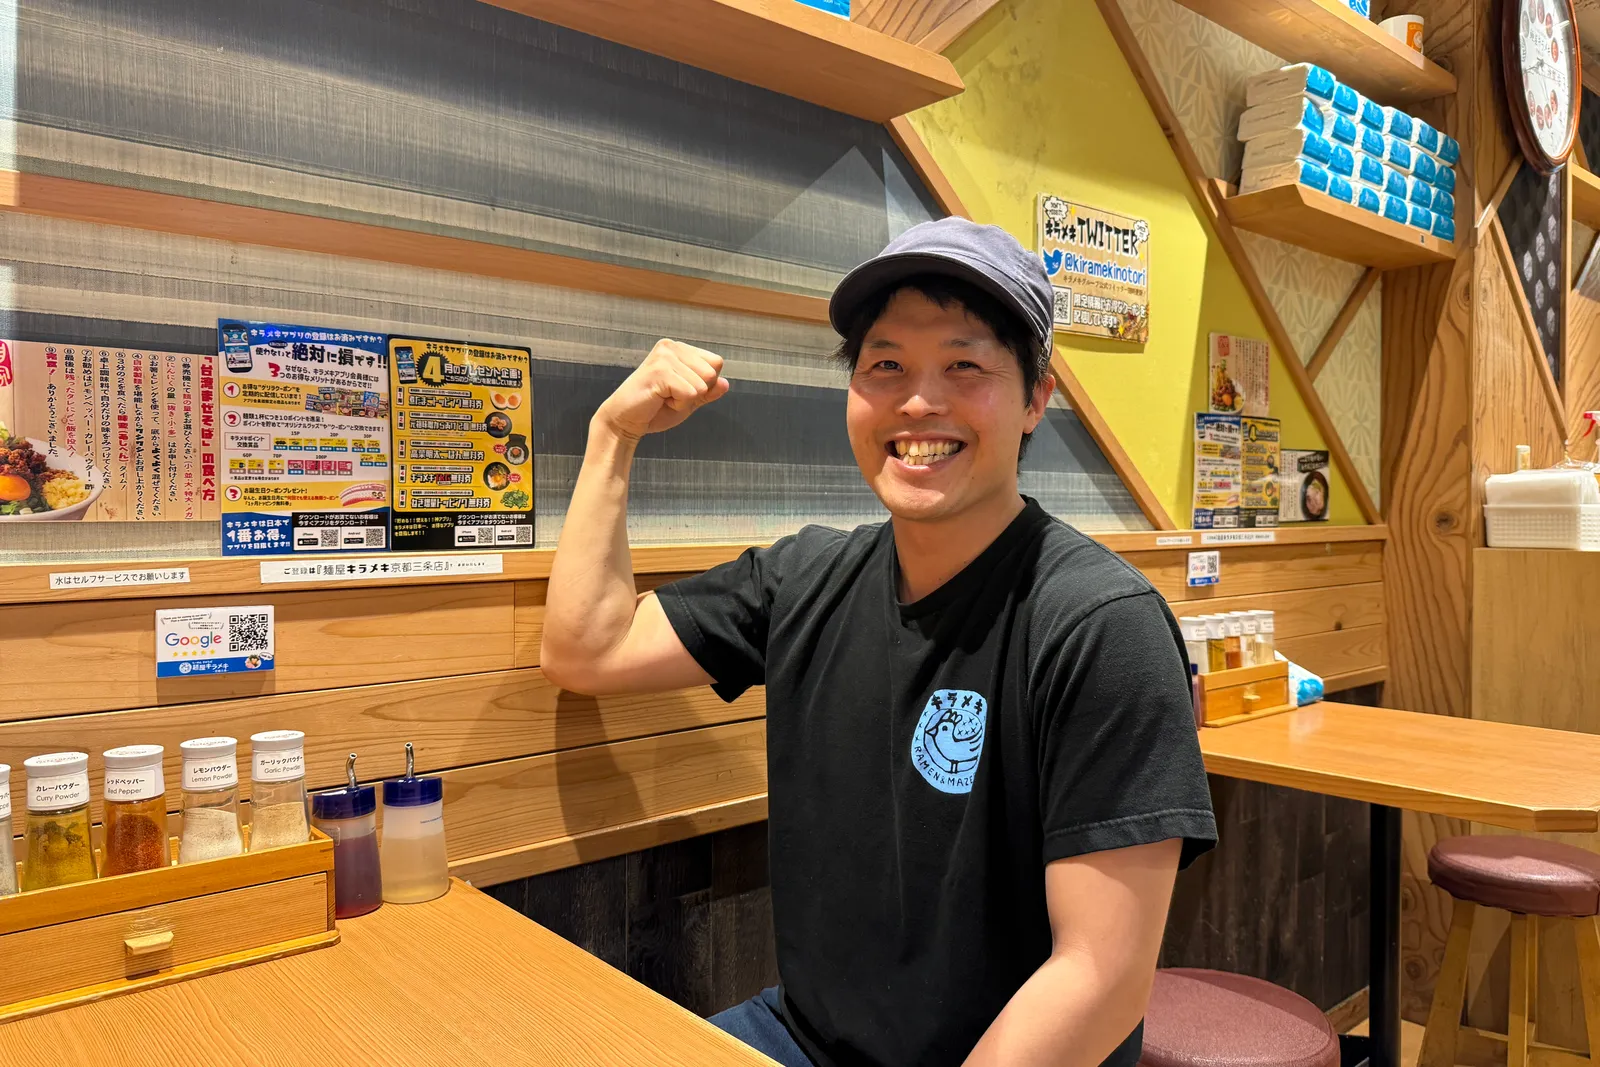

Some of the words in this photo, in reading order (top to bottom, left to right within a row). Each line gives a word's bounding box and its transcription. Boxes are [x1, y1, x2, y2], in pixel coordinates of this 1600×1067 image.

[1045, 218, 1076, 243] キラメキ
[1077, 216, 1139, 256] TWITTER
[1064, 252, 1146, 286] @kiramekinotori
[422, 355, 445, 383] 4
[200, 356, 216, 502] 「台湾まぜそば」の食べ方
[226, 518, 290, 529] キラメキは日本で
[54, 570, 187, 586] 水はセルフサービスでお願いします
[164, 631, 222, 649] Google
[931, 691, 983, 716] キラメキ
[192, 763, 232, 775] レモンパウダー
[264, 766, 282, 775] Garlic
[191, 775, 212, 783] Lemon
[212, 773, 233, 781] Powder
[35, 782, 80, 793] カレーパウダー
[107, 787, 118, 795] Red
[118, 786, 142, 796] Pepper
[35, 793, 54, 803] Curry
[54, 791, 80, 801] Powder
